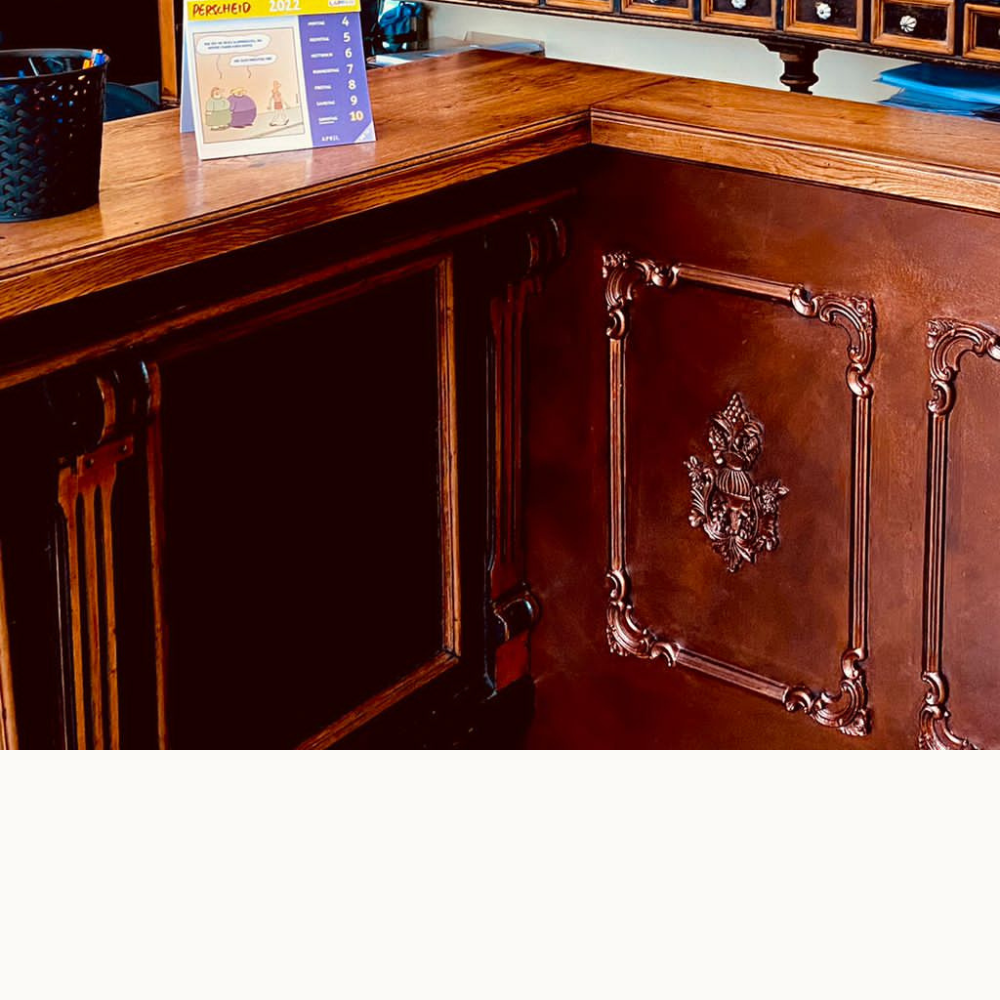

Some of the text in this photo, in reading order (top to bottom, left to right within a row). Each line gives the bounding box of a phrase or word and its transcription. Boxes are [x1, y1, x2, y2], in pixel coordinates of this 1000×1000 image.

[192, 1, 251, 17] PERSCHEID
[269, 0, 300, 12] 2022
[341, 16, 350, 26] 4
[343, 32, 351, 43] 5
[345, 47, 353, 58] 6
[346, 63, 354, 74] 7
[348, 79, 356, 90] 8
[350, 95, 358, 106] 9
[349, 110, 364, 122] 10
